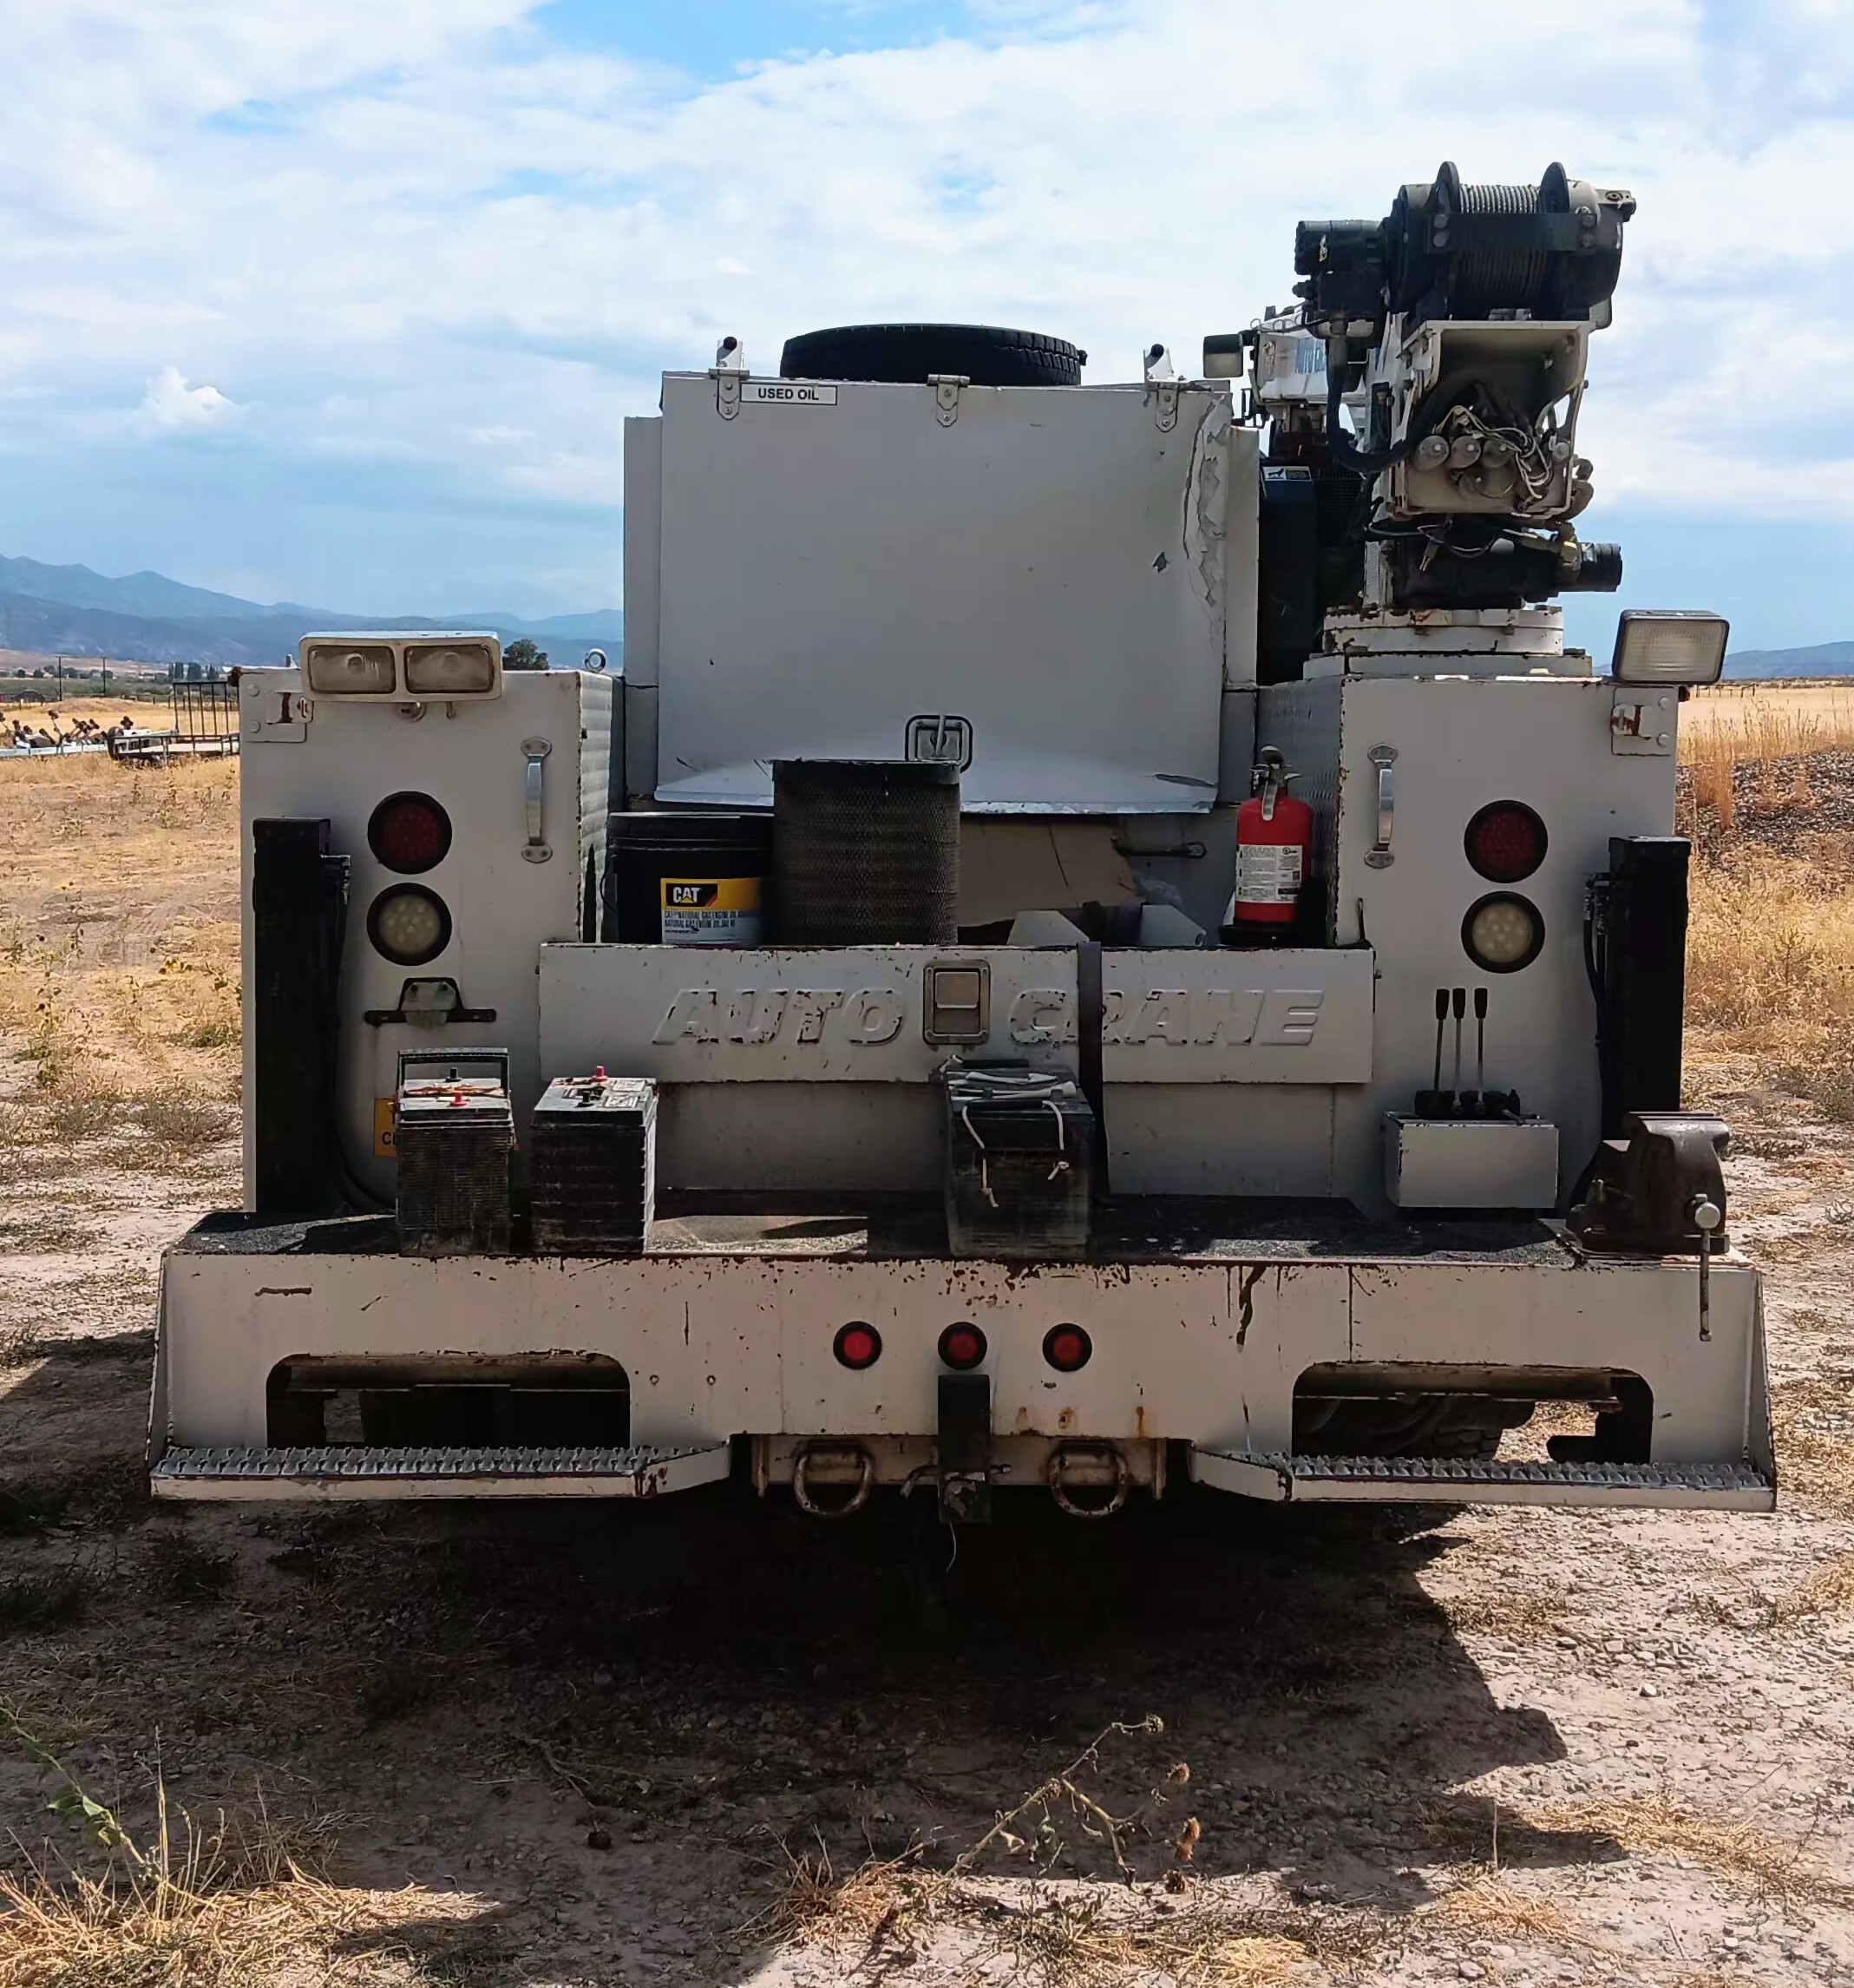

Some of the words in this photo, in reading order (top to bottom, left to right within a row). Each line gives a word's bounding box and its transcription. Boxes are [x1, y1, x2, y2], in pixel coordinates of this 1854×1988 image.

[757, 387, 794, 399] USED
[797, 389, 819, 401] OIL
[672, 886, 700, 903] CAT
[652, 988, 907, 1046] AUTO
[1007, 987, 1324, 1046] CRANE
